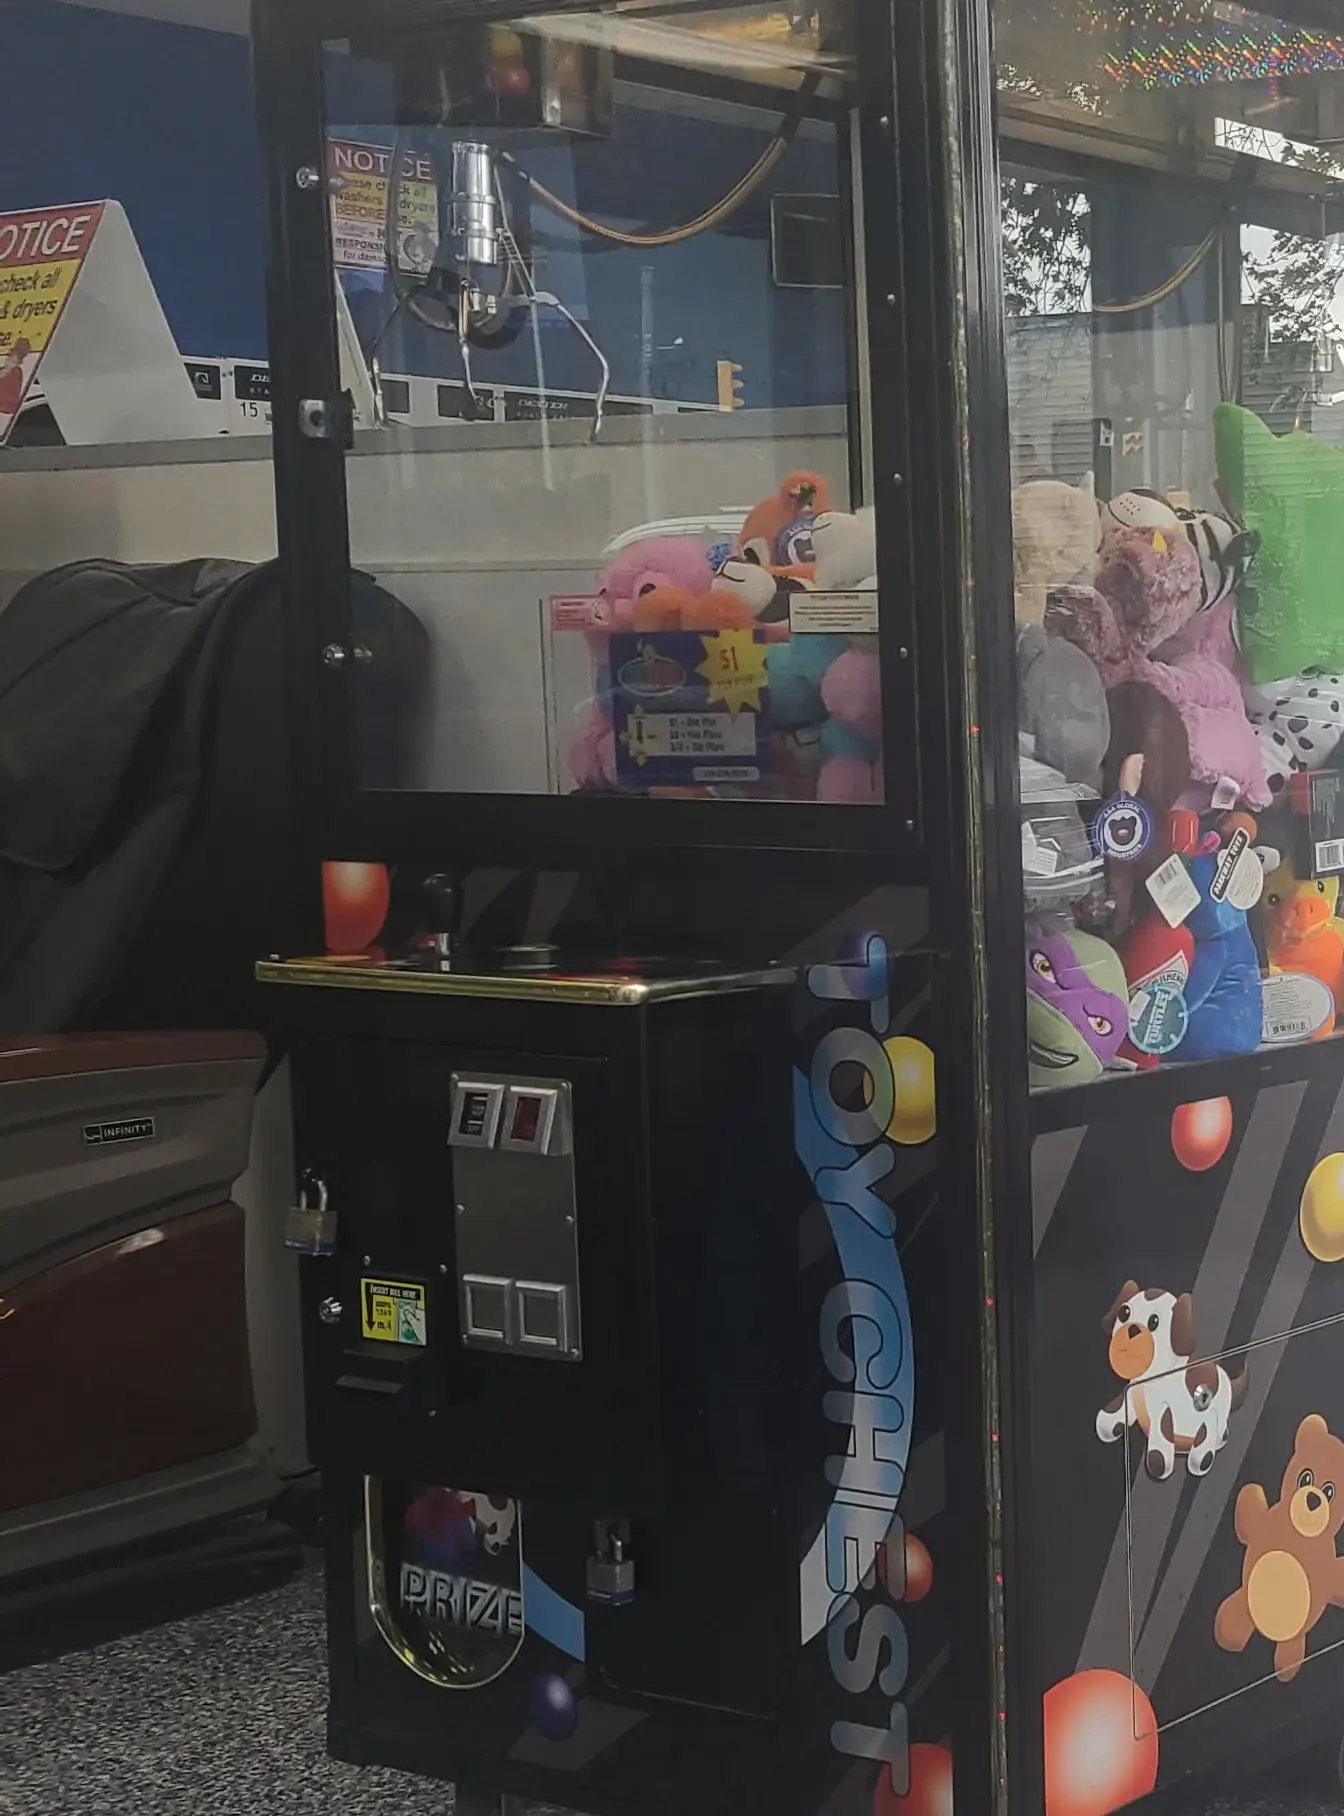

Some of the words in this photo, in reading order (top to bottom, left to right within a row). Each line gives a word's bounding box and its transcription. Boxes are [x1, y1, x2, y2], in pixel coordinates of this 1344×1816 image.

[334, 146, 432, 180] NOTCE
[240, 402, 258, 418] 15
[719, 646, 740, 671] $1
[807, 934, 897, 1240] TOY
[103, 1123, 147, 1138] INFINITY
[819, 1277, 911, 1798] CHEST
[400, 1562, 523, 1637] PRIZE
